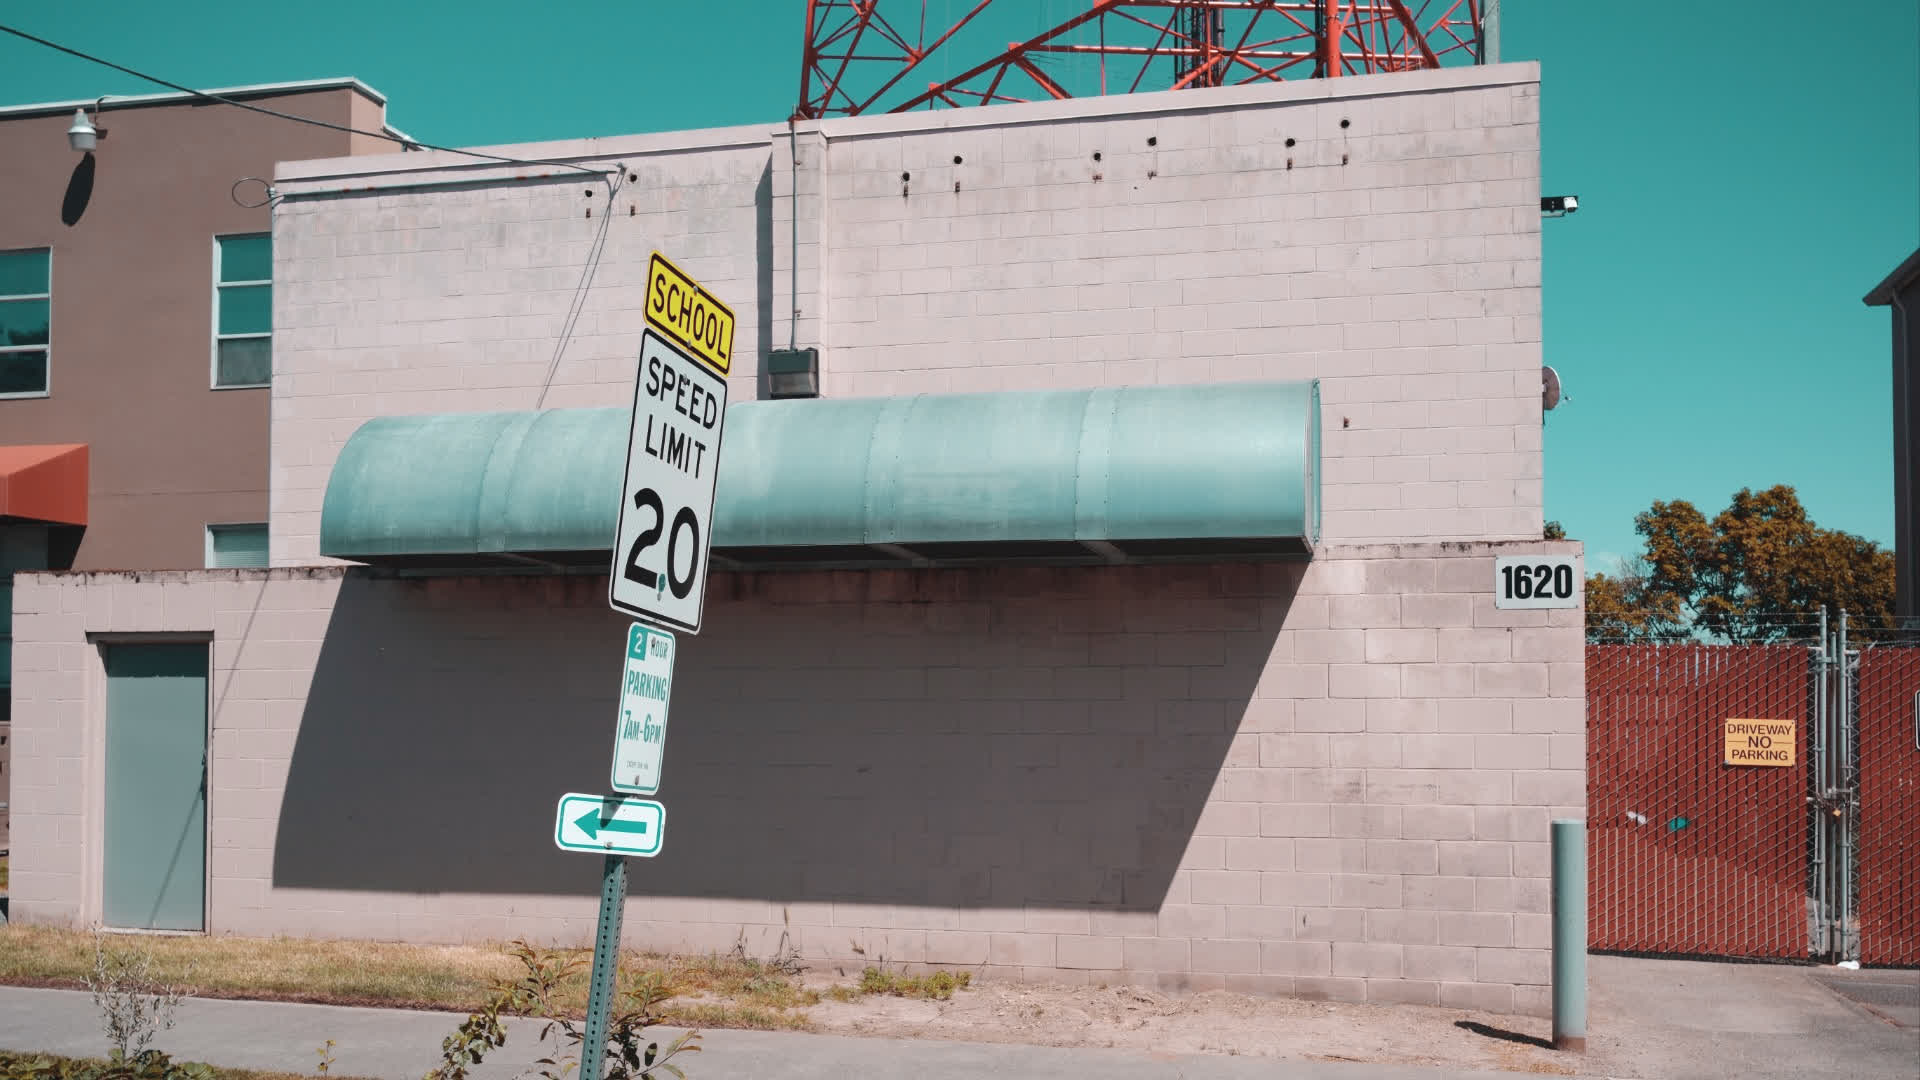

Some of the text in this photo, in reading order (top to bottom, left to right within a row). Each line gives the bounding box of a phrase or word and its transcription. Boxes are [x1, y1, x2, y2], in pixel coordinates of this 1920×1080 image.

[653, 273, 727, 360] SCHOOL
[646, 356, 717, 429] SPEED
[645, 414, 706, 479] LIMIT
[624, 488, 700, 599] 20
[1501, 564, 1573, 599] 1620
[633, 632, 643, 654] 2
[627, 669, 667, 702] PARKING
[1727, 724, 1792, 735] DRIVEWAY
[1748, 735, 1772, 749] NO
[1731, 749, 1789, 761] PARKING
